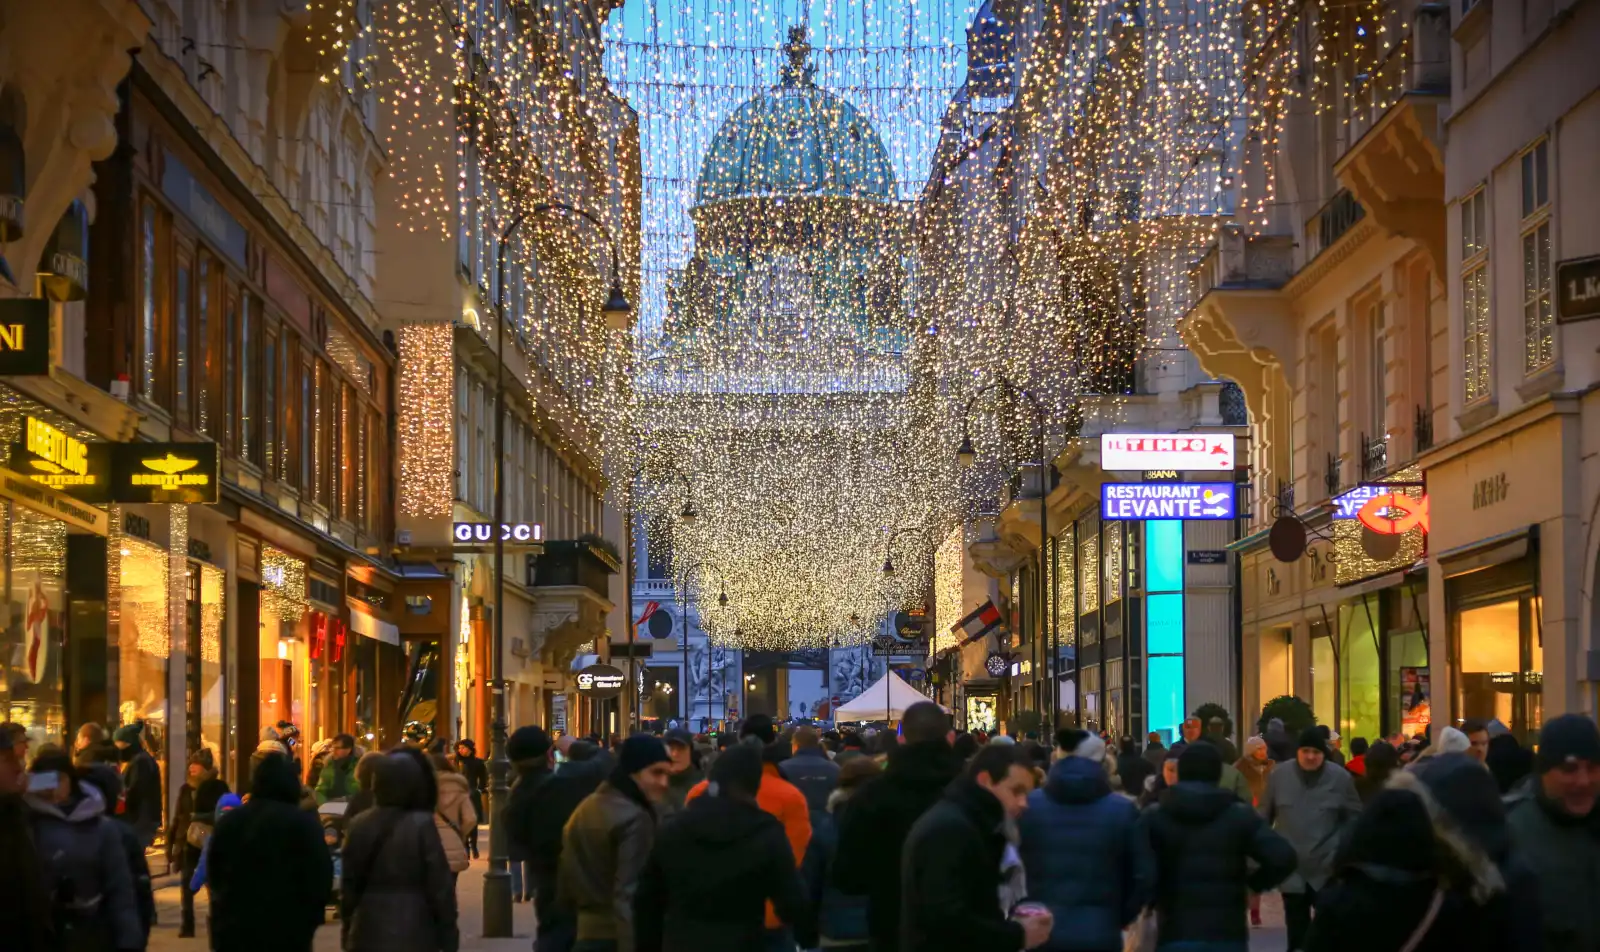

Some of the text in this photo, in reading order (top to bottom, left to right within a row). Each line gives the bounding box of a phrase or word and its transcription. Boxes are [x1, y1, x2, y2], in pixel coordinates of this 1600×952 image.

[1108, 439, 1206, 452] IL TEMPO
[132, 474, 209, 485] BREITLING
[1107, 486, 1201, 498] RESTAURANT
[1107, 500, 1201, 516] LEVANTE
